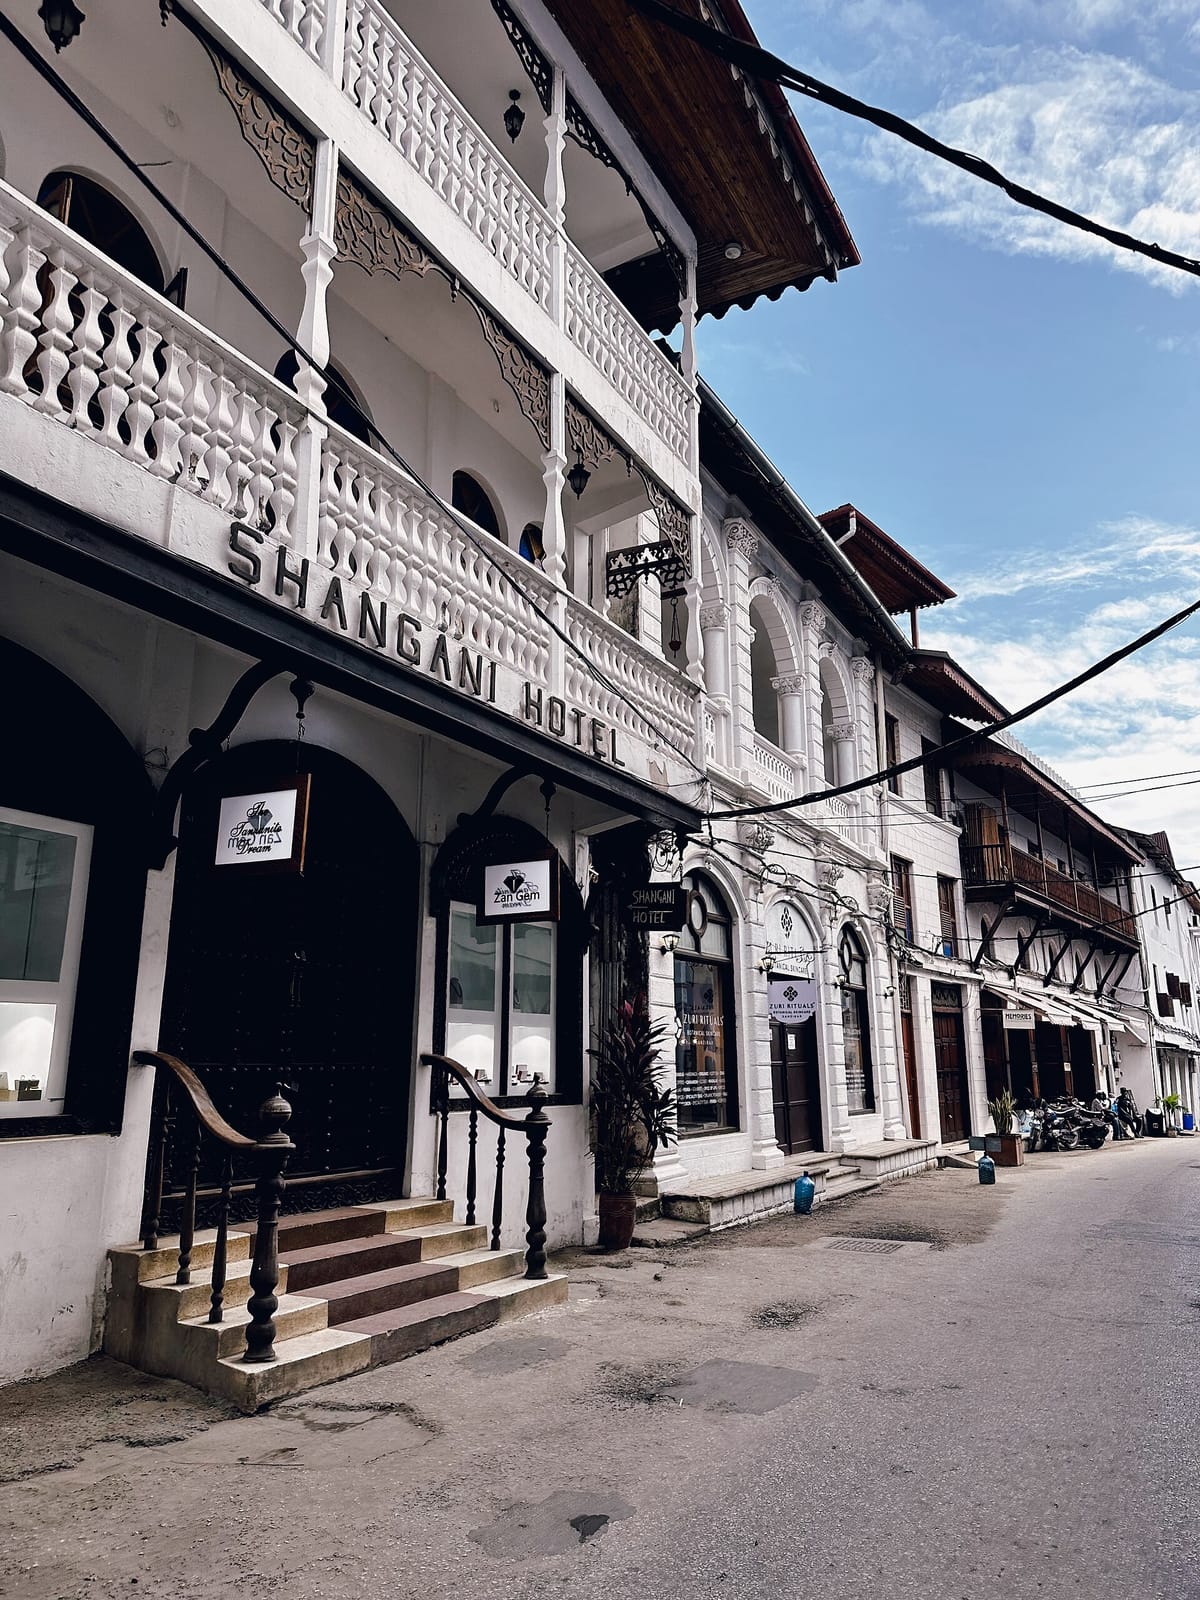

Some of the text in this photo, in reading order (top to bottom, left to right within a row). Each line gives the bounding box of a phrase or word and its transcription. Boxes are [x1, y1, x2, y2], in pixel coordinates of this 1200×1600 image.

[228, 521, 626, 767] SHANGANI HOTEL
[493, 889, 540, 903] Zan Gem
[632, 888, 675, 904] SHANGANI
[632, 911, 665, 924] HOTEL
[683, 1013, 724, 1026] ZURI RITUALS
